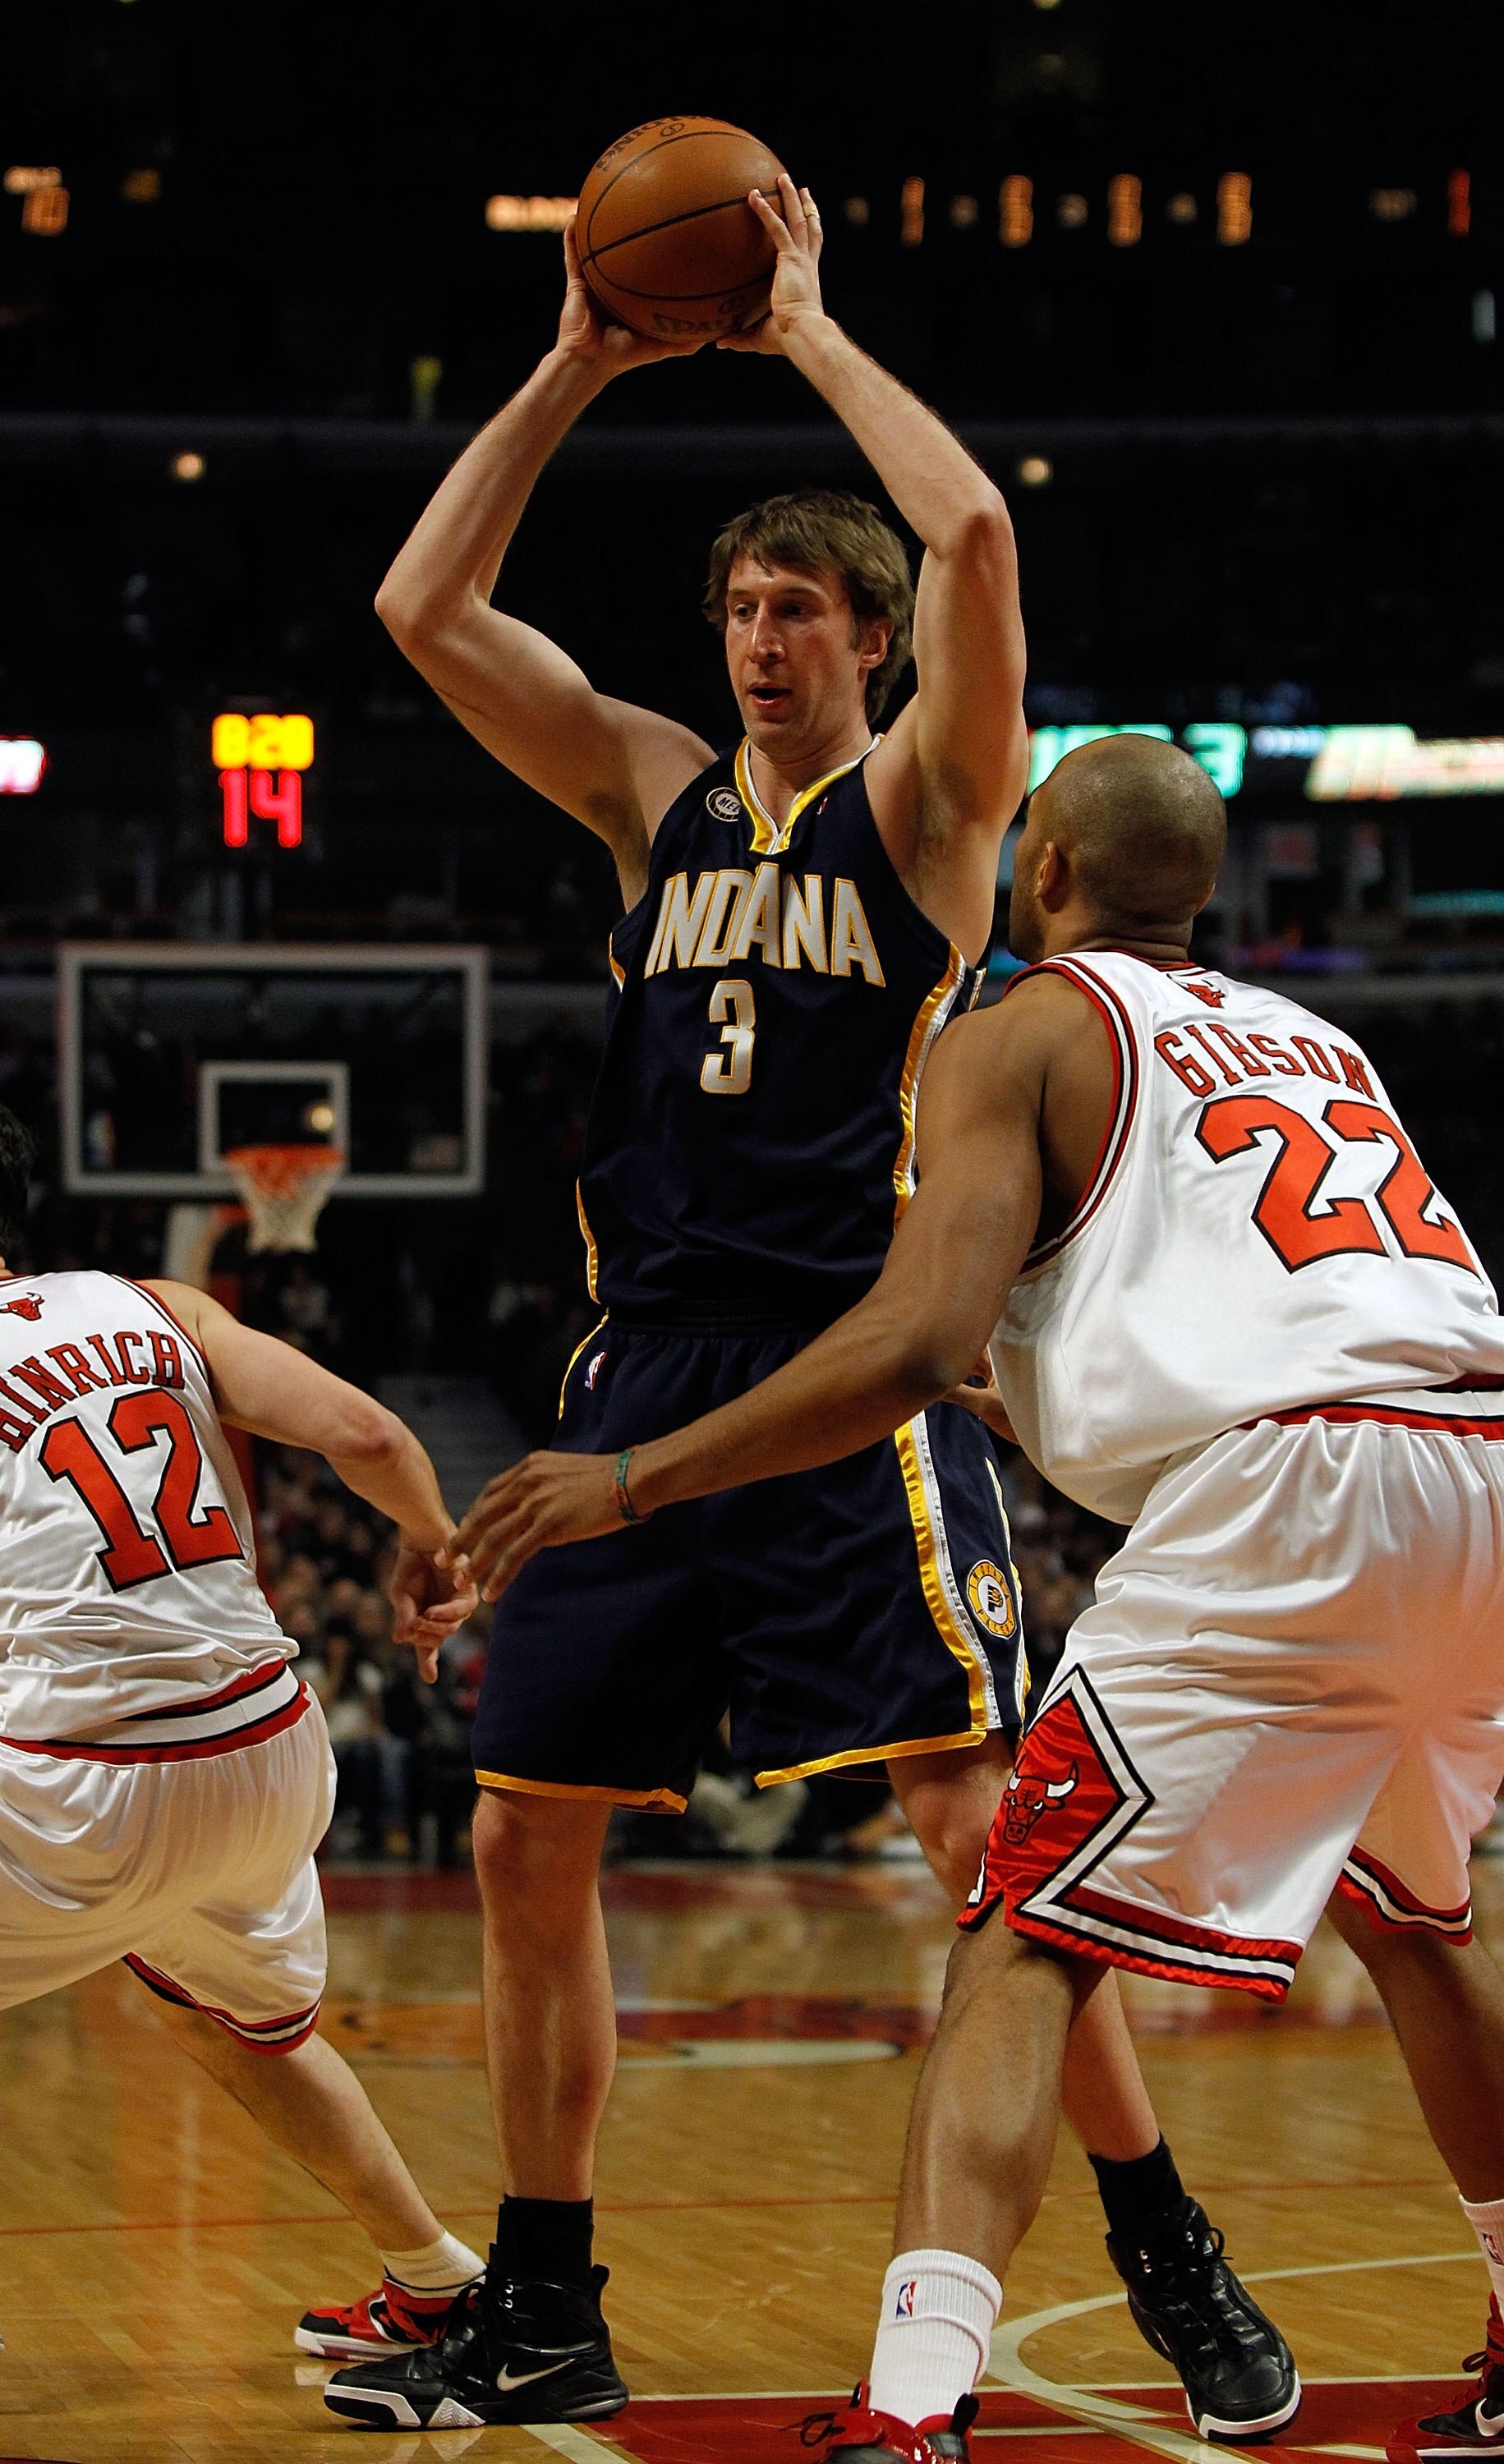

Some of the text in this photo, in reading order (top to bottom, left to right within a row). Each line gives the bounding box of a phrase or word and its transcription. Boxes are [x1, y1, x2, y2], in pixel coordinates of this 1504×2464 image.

[218, 767, 301, 848] 14
[644, 861, 885, 988] INDANA
[700, 978, 757, 1095] 3
[1154, 1023, 1379, 1101] GIBSON
[1194, 1094, 1483, 1284] 22
[38, 1386, 246, 1593] 12
